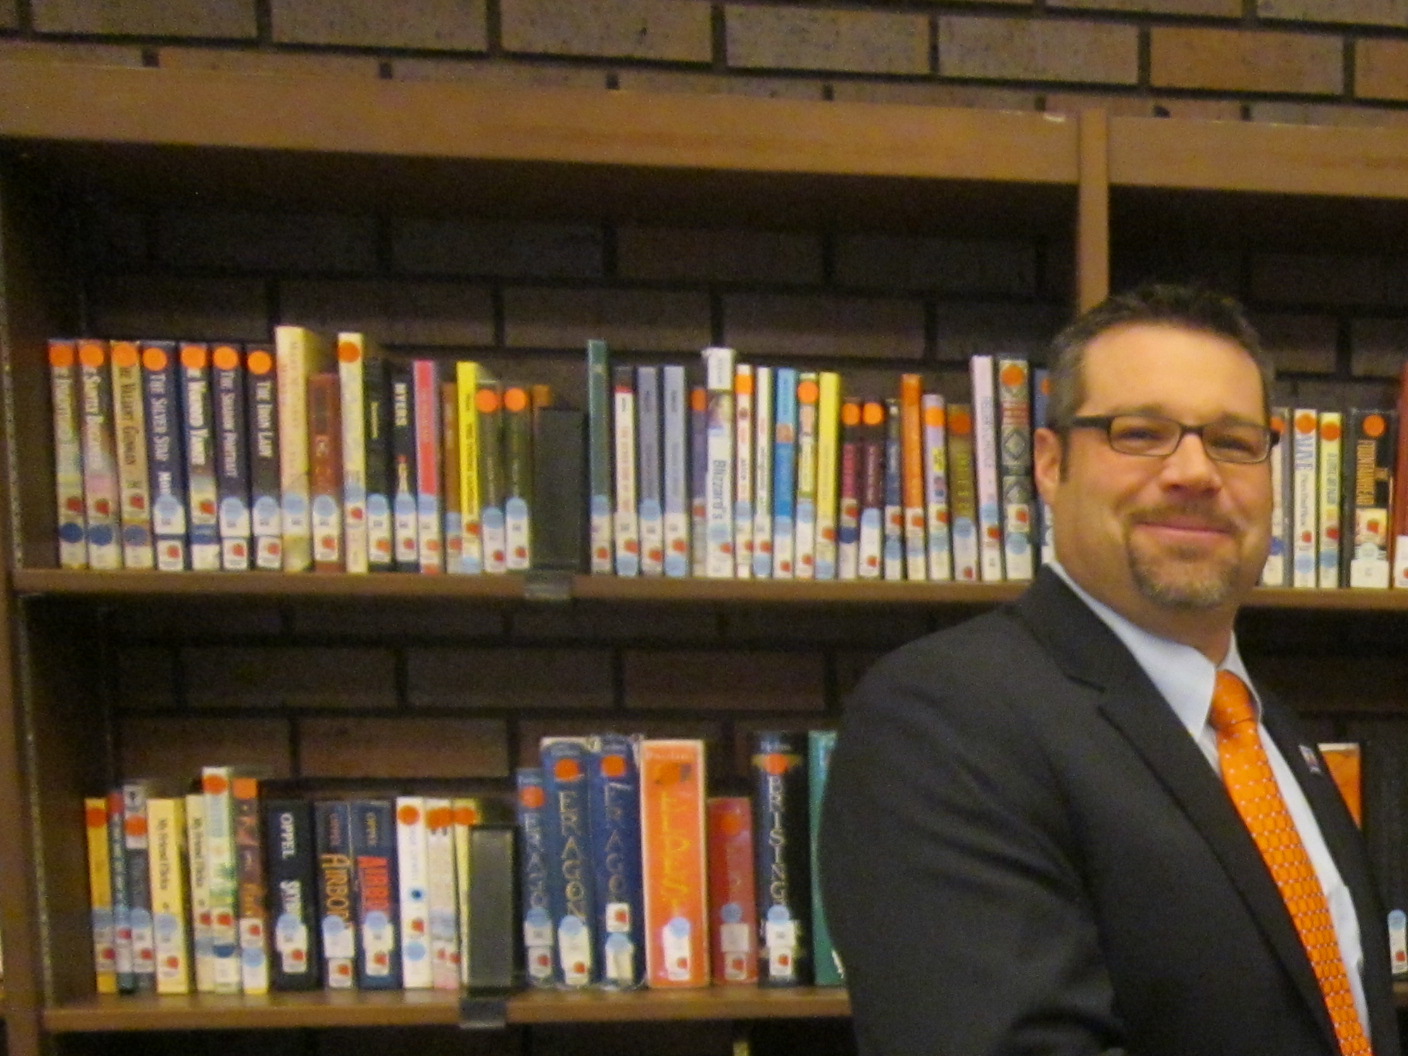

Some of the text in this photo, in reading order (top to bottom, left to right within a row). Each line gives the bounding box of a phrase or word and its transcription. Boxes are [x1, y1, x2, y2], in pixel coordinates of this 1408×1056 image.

[712, 460, 728, 521] Blizzard's
[280, 812, 297, 860] OPPEL
[523, 812, 546, 907] ERAGO
[767, 776, 791, 906] BRISING
[321, 855, 353, 920] AIRBOR
